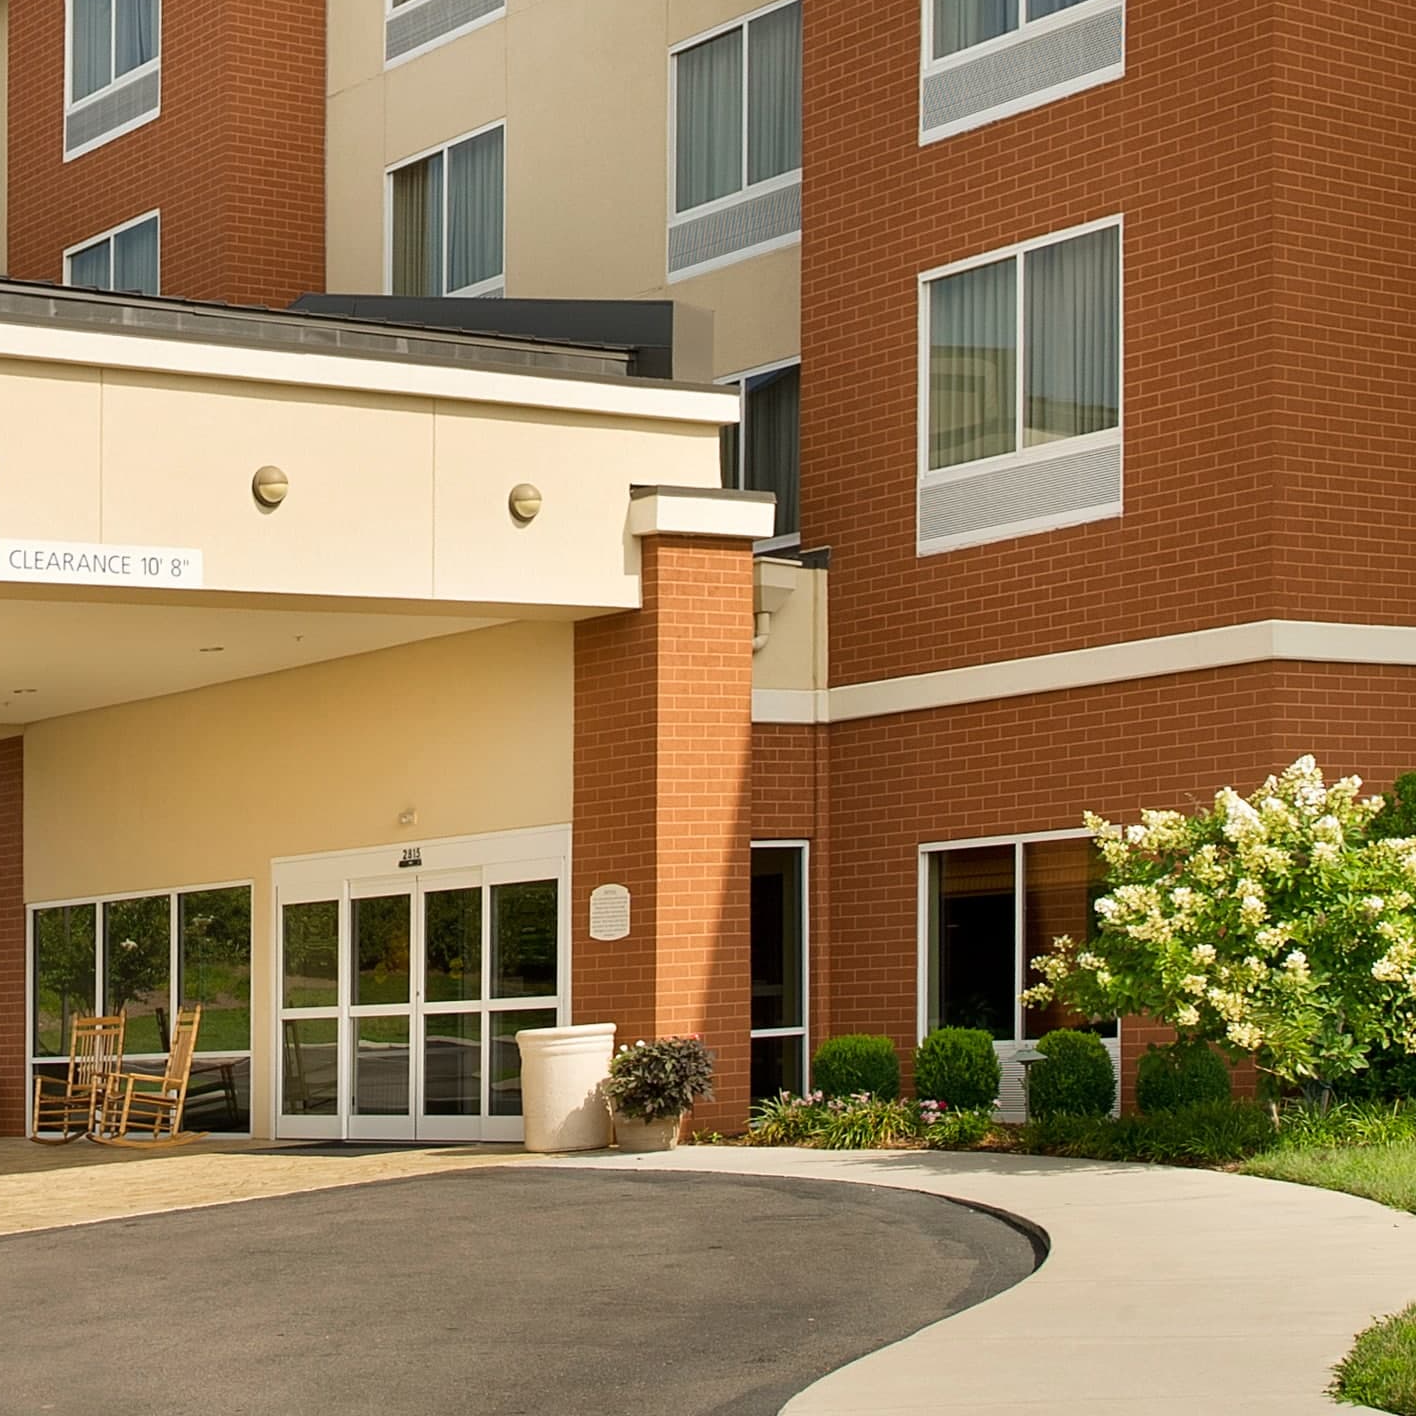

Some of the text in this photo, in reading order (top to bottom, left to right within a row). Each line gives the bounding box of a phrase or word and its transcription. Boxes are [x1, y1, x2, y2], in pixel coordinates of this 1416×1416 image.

[8, 549, 190, 577] CLEARANCE 10' 8"
[402, 847, 421, 860] 2815
